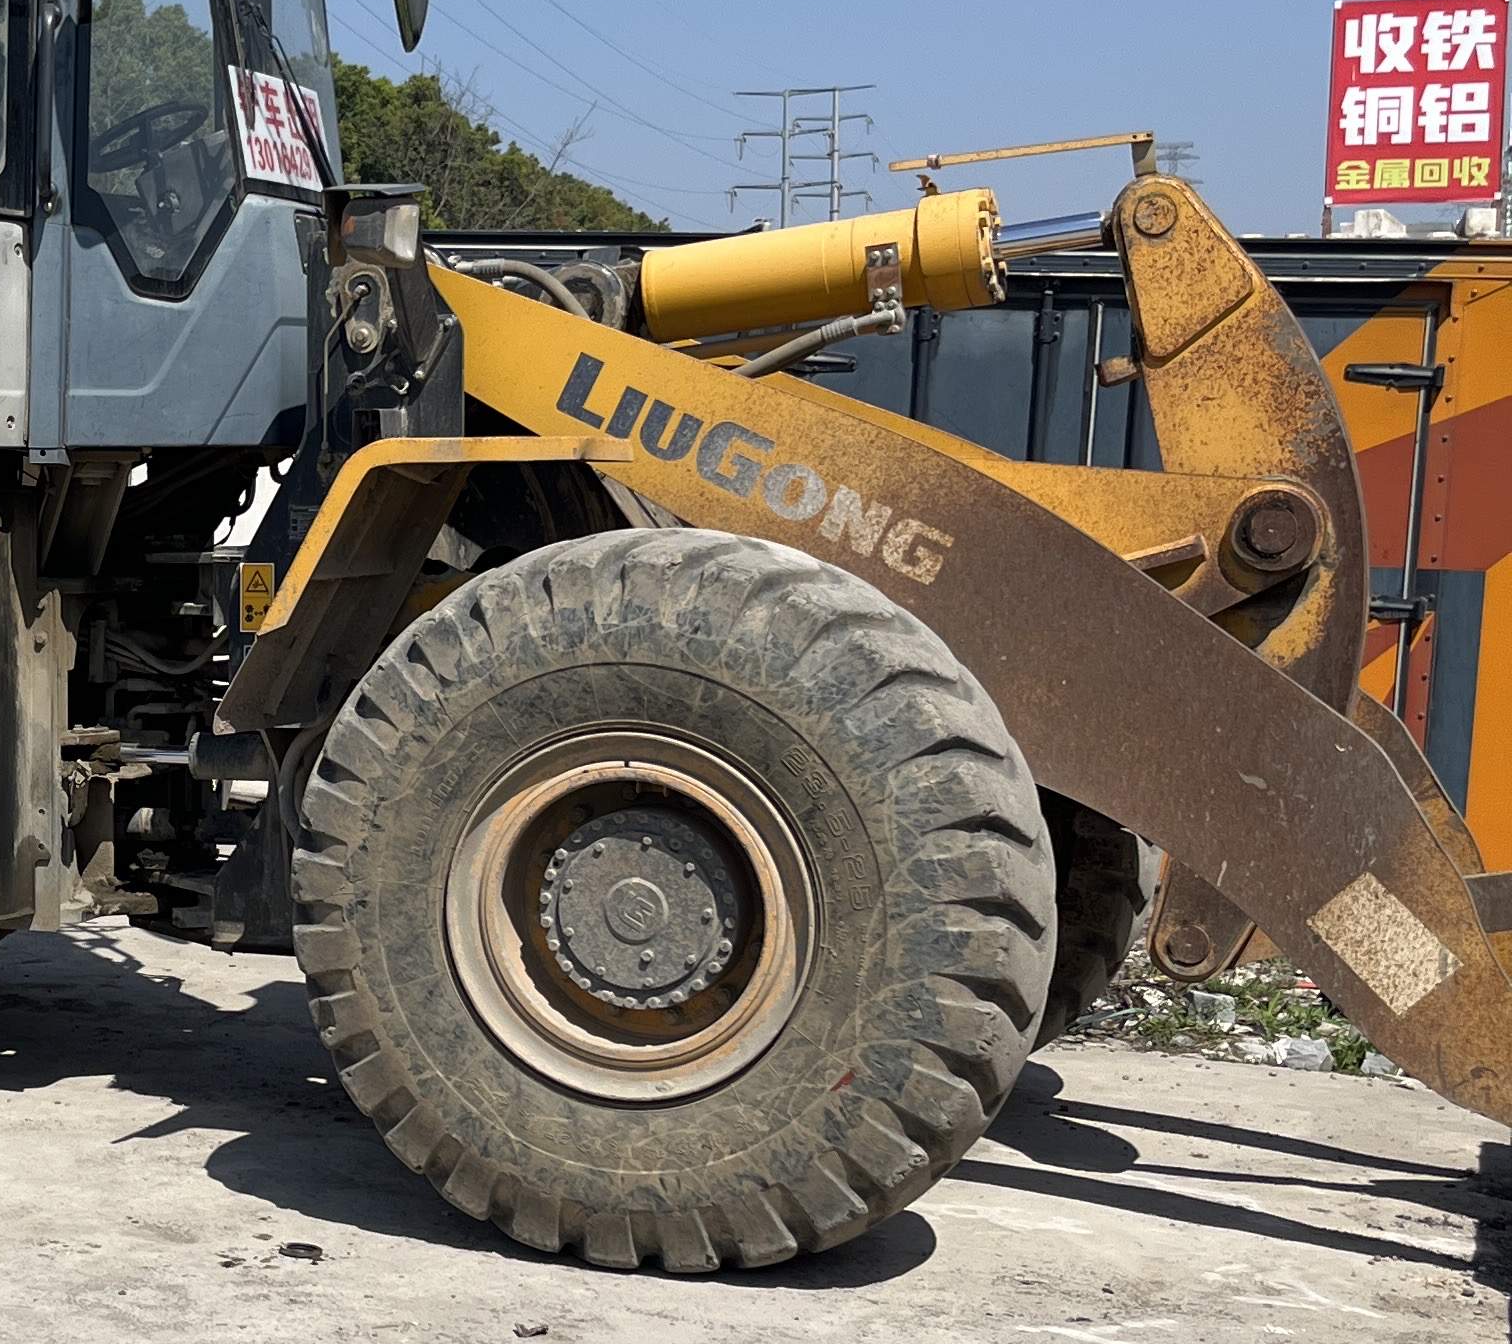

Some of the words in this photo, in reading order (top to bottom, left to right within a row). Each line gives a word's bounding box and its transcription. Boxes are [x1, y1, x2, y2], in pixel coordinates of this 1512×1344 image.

[1344, 9, 1497, 74] 收铁
[1339, 82, 1490, 146] 铜铝
[1335, 156, 1491, 190] 金属回收
[555, 351, 955, 586] LIUGONG
[780, 744, 873, 912] 23.5-25
